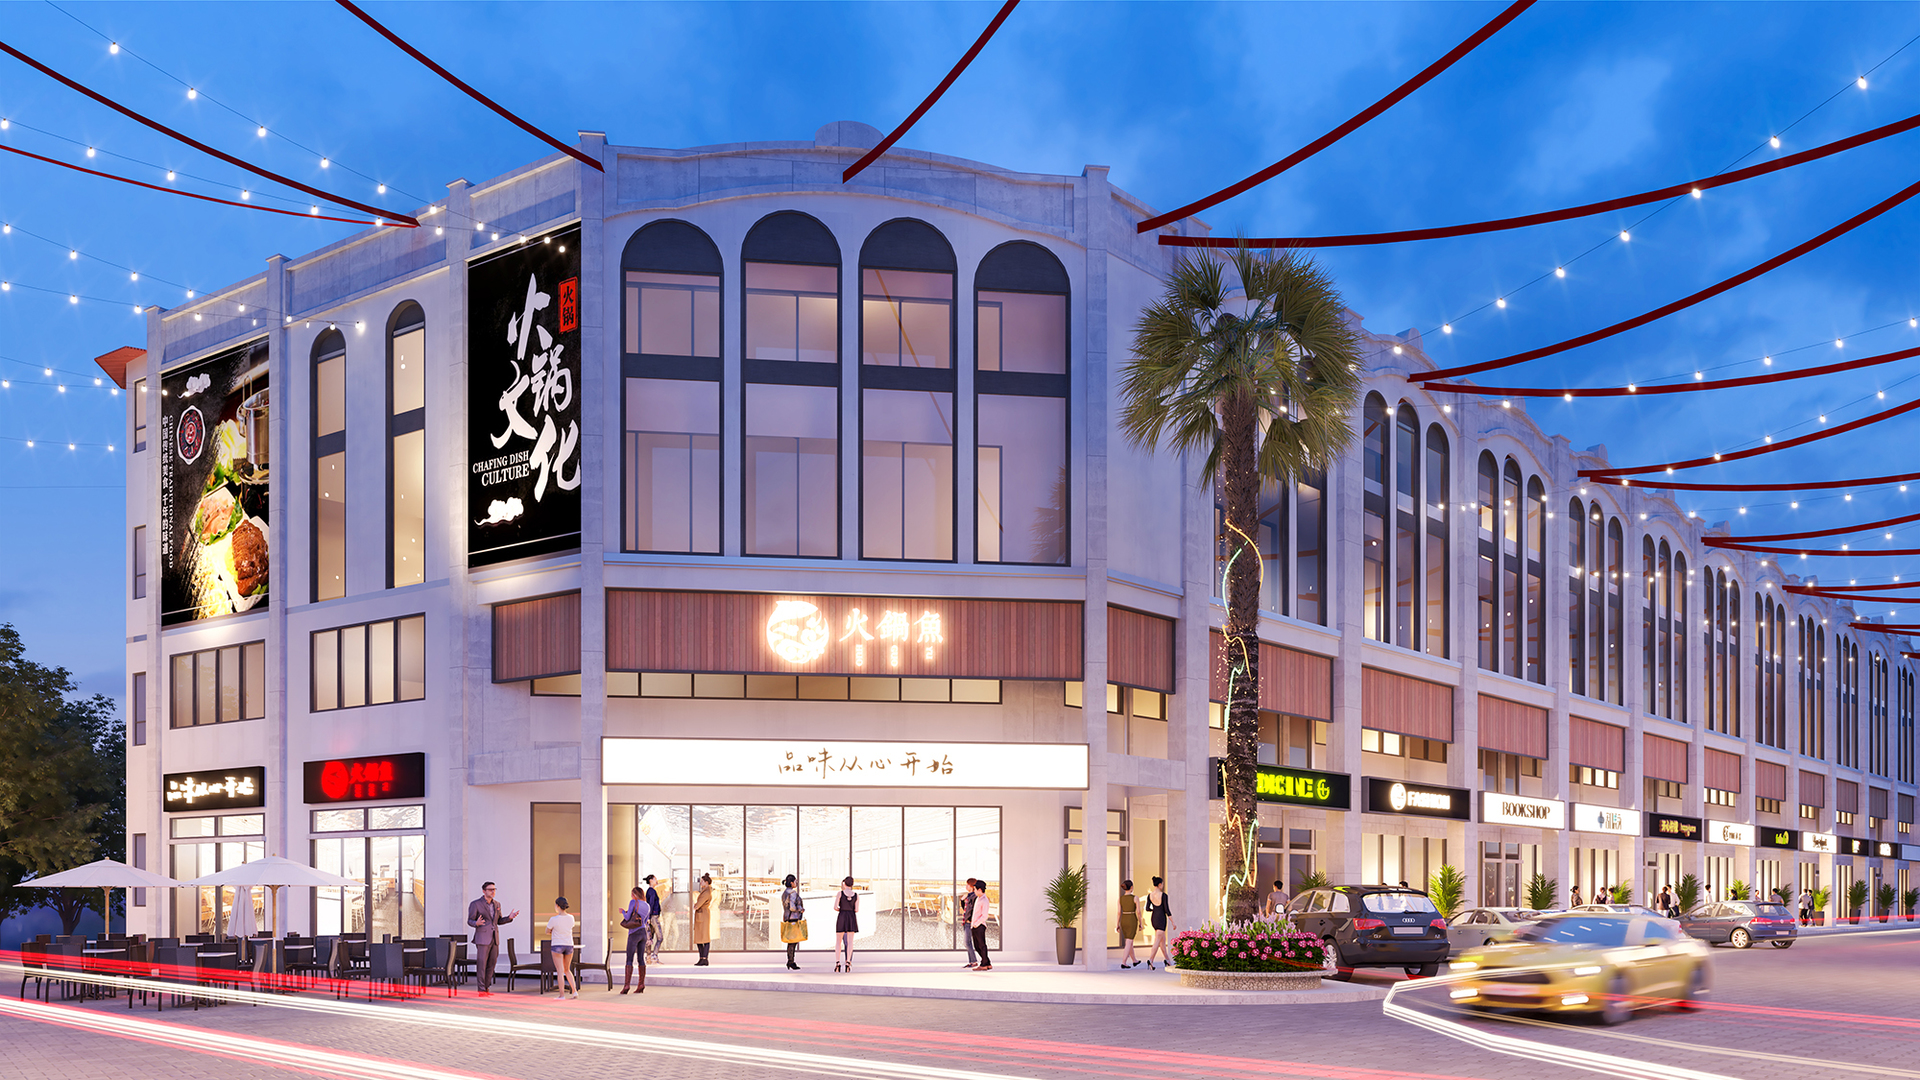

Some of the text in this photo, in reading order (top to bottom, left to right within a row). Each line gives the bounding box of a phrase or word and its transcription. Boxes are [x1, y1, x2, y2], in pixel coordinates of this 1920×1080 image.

[563, 286, 574, 326] 火锅
[490, 272, 581, 502] 火锅文化
[472, 450, 530, 474] CHAFING DISH
[481, 463, 530, 487] CULTURE
[839, 607, 944, 644] 火鍋魚
[855, 643, 864, 667] HUO
[890, 644, 899, 667] GUO
[778, 747, 954, 780] 品味从心开始
[1257, 772, 1314, 798] DICINE
[1502, 801, 1551, 820] BOOKSHOP
